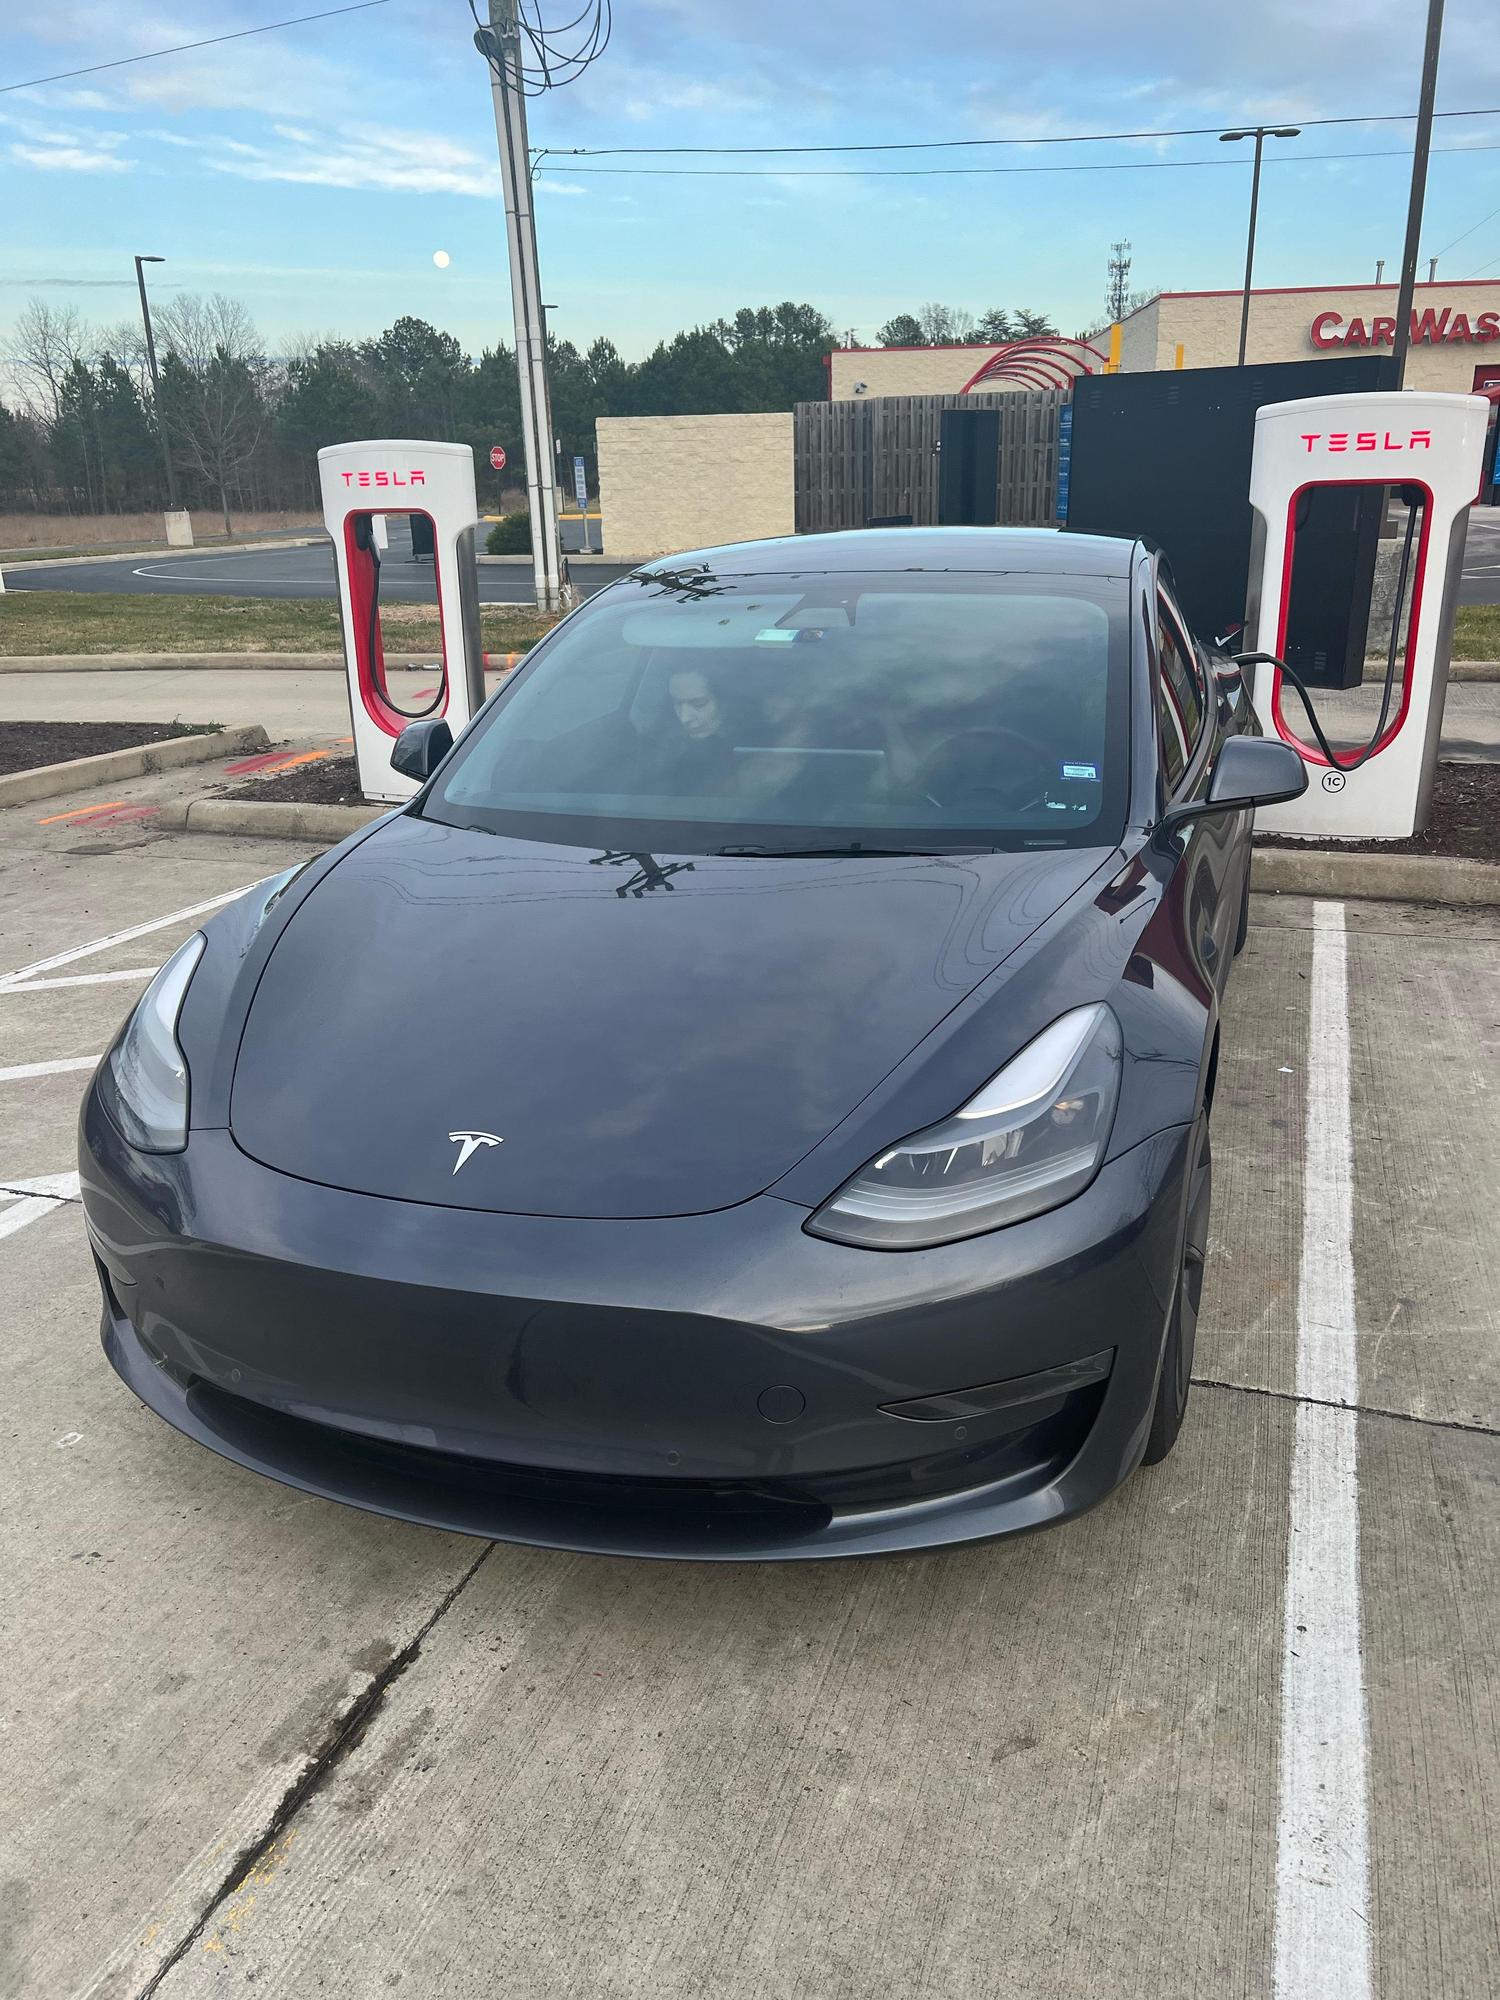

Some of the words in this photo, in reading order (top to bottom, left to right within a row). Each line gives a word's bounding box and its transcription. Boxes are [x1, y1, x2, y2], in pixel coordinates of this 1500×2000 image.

[1311, 311, 1396, 349] CAR
[1300, 430, 1431, 452] TESLA
[491, 453, 504, 462] STOP
[341, 471, 425, 487] TESLA
[1327, 777, 1341, 786] 1C
